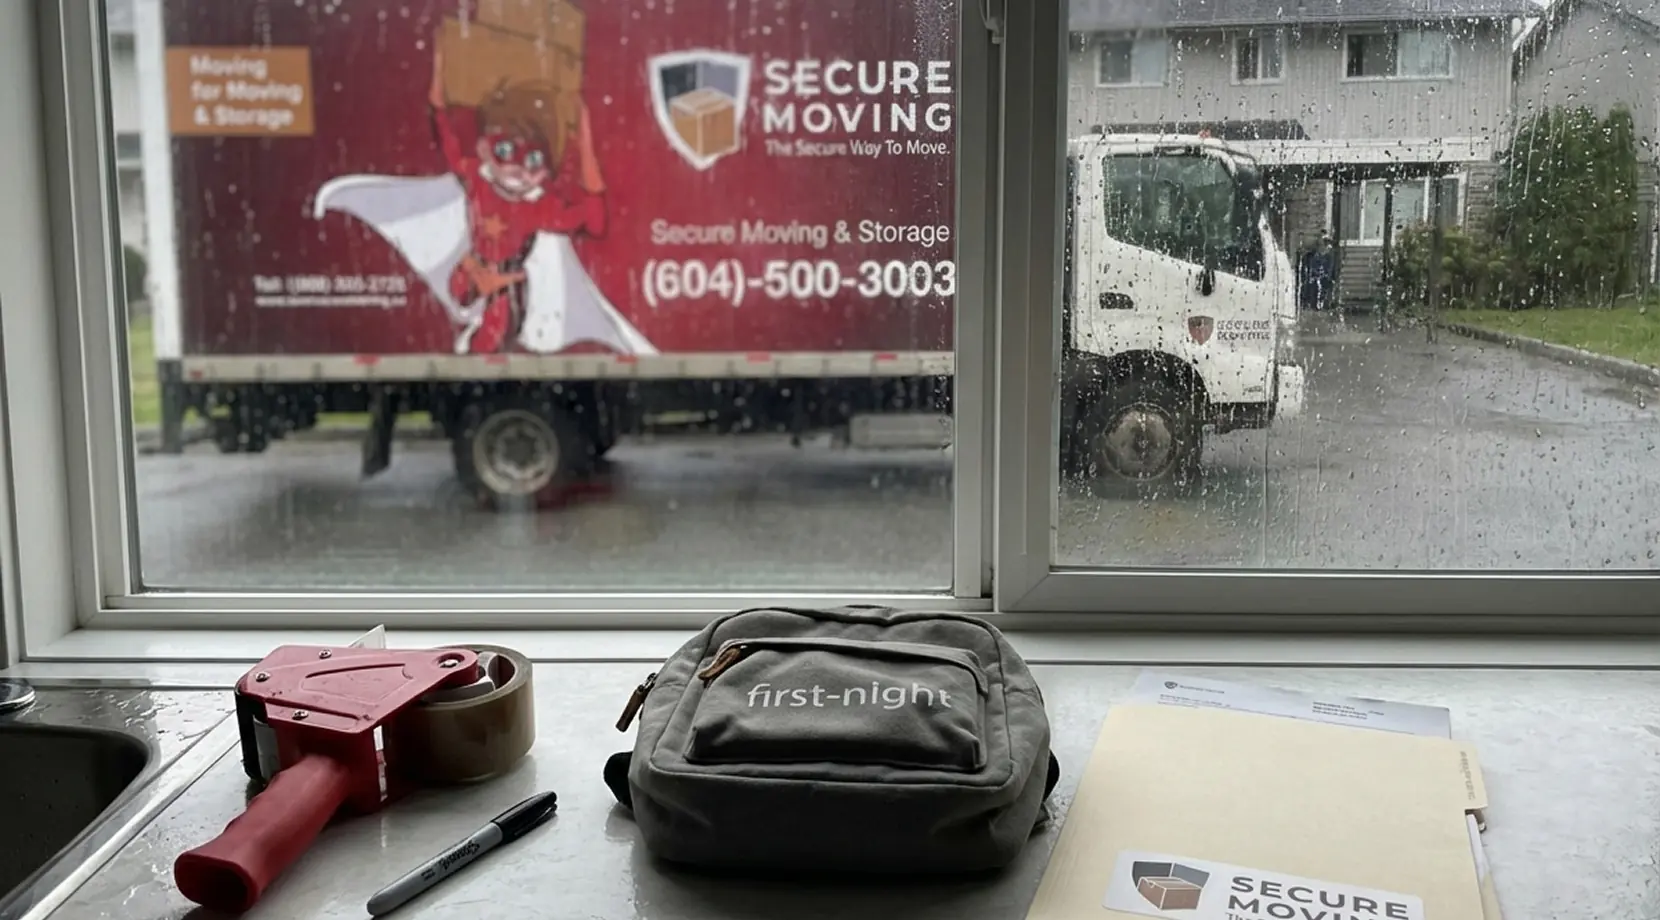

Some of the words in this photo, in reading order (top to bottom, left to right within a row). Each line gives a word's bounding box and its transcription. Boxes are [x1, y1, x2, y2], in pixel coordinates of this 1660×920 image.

[190, 54, 268, 79] Moving
[764, 60, 952, 95] SECURE
[225, 80, 303, 105] Moving
[213, 104, 294, 131] Storage
[762, 103, 952, 133] MOVING
[765, 139, 793, 156] The
[795, 139, 847, 157] Secure
[850, 140, 881, 159] Way
[885, 140, 903, 155] To
[906, 140, 950, 155] Move.
[650, 219, 735, 245] Secure
[741, 219, 828, 248] Moving
[834, 220, 851, 243] &
[858, 219, 950, 247] Storage
[642, 258, 956, 307] (604)-500-3003
[747, 681, 952, 710] first-night
[1230, 876, 1409, 920] SECURE
